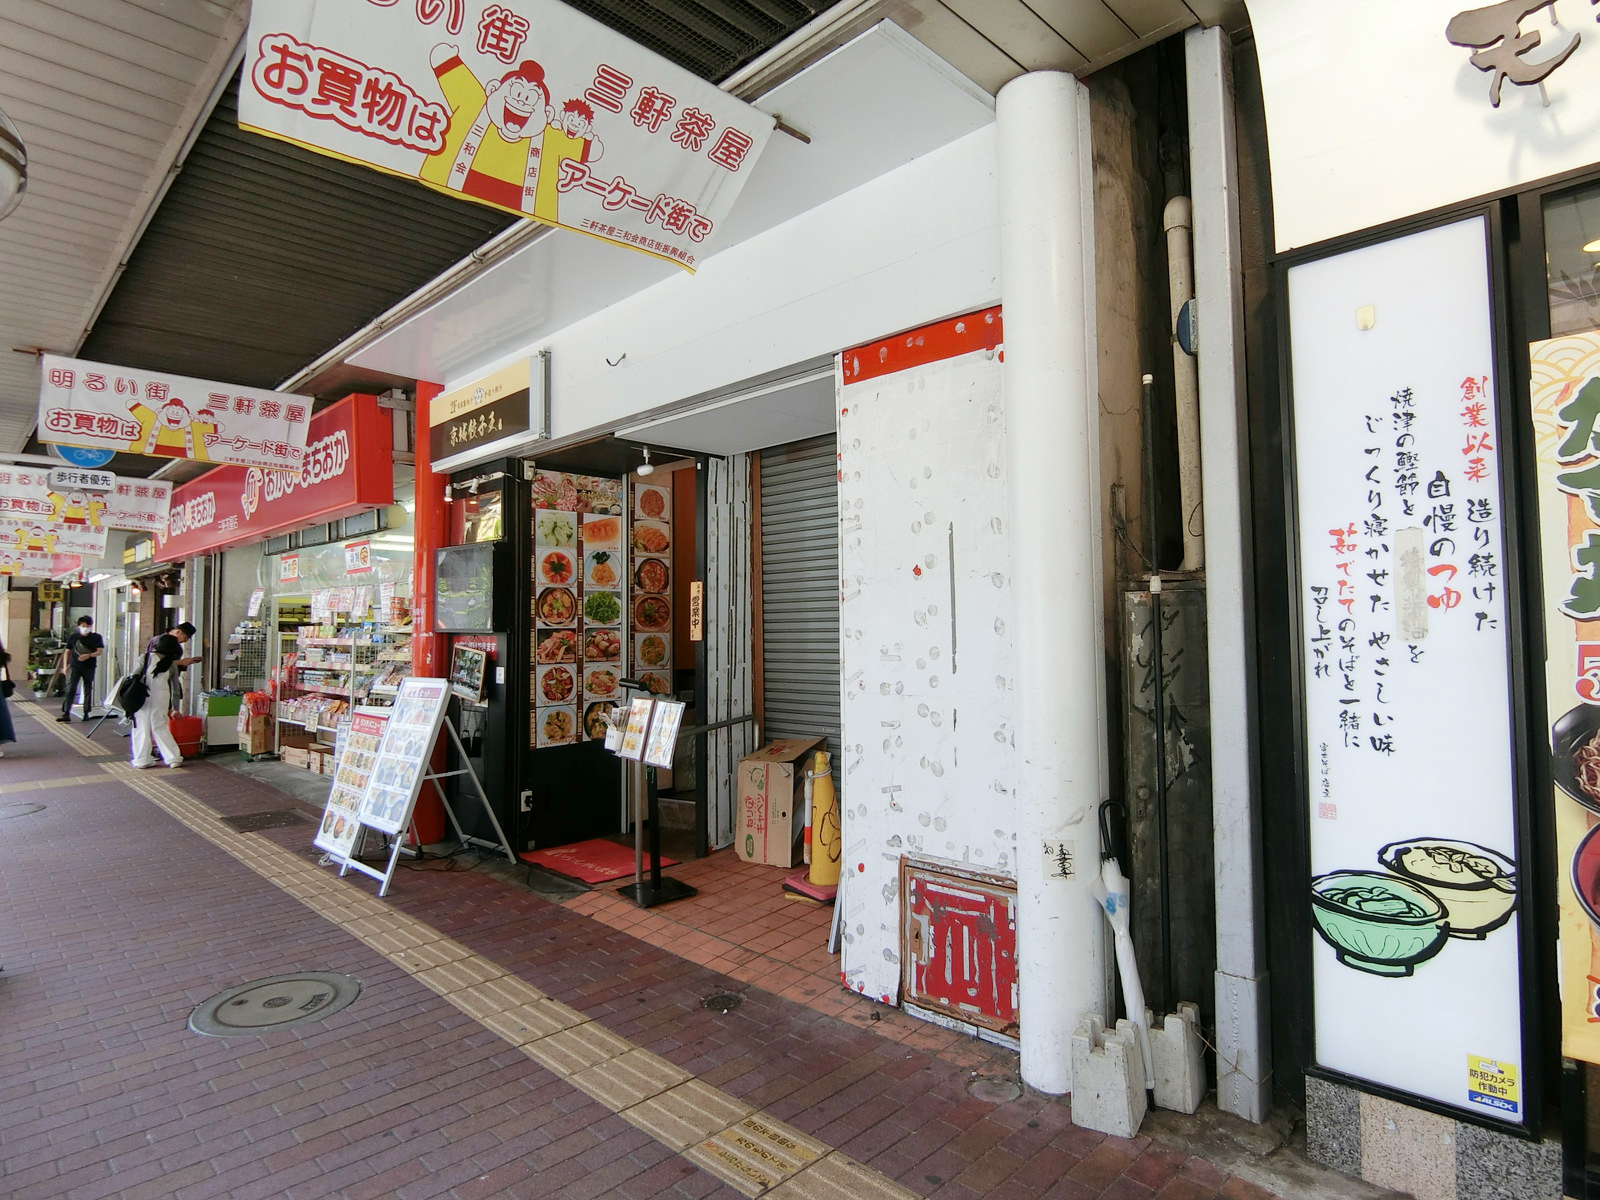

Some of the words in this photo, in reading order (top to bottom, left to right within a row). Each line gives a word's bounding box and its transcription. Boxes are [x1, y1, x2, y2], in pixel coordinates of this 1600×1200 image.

[258, 38, 446, 148] お買物は
[583, 64, 754, 173] 三軒茶屋
[454, 123, 485, 176] 三和会
[524, 146, 541, 198] 商店街
[557, 158, 715, 243] アーケード街で
[579, 217, 696, 266] 三軒茶屋三和会商店街振興組合
[49, 368, 170, 401] 明るい街
[206, 391, 306, 424] 三軒茶屋
[47, 408, 142, 440] お買物は
[203, 433, 303, 460] アーケード街で
[1460, 375, 1494, 484] 創業以来
[56, 471, 112, 487] 歩行者優先
[116, 483, 167, 500] 軒茶屋
[1422, 470, 1463, 615] 自慢のつゆ
[1466, 498, 1498, 632] 造り続けた
[691, 595, 700, 629] 営業中
[1469, 1068, 1515, 1087] 防犯カメラ
[1478, 1082, 1508, 1096] 作動中
[1482, 1097, 1514, 1112] ALSOK
